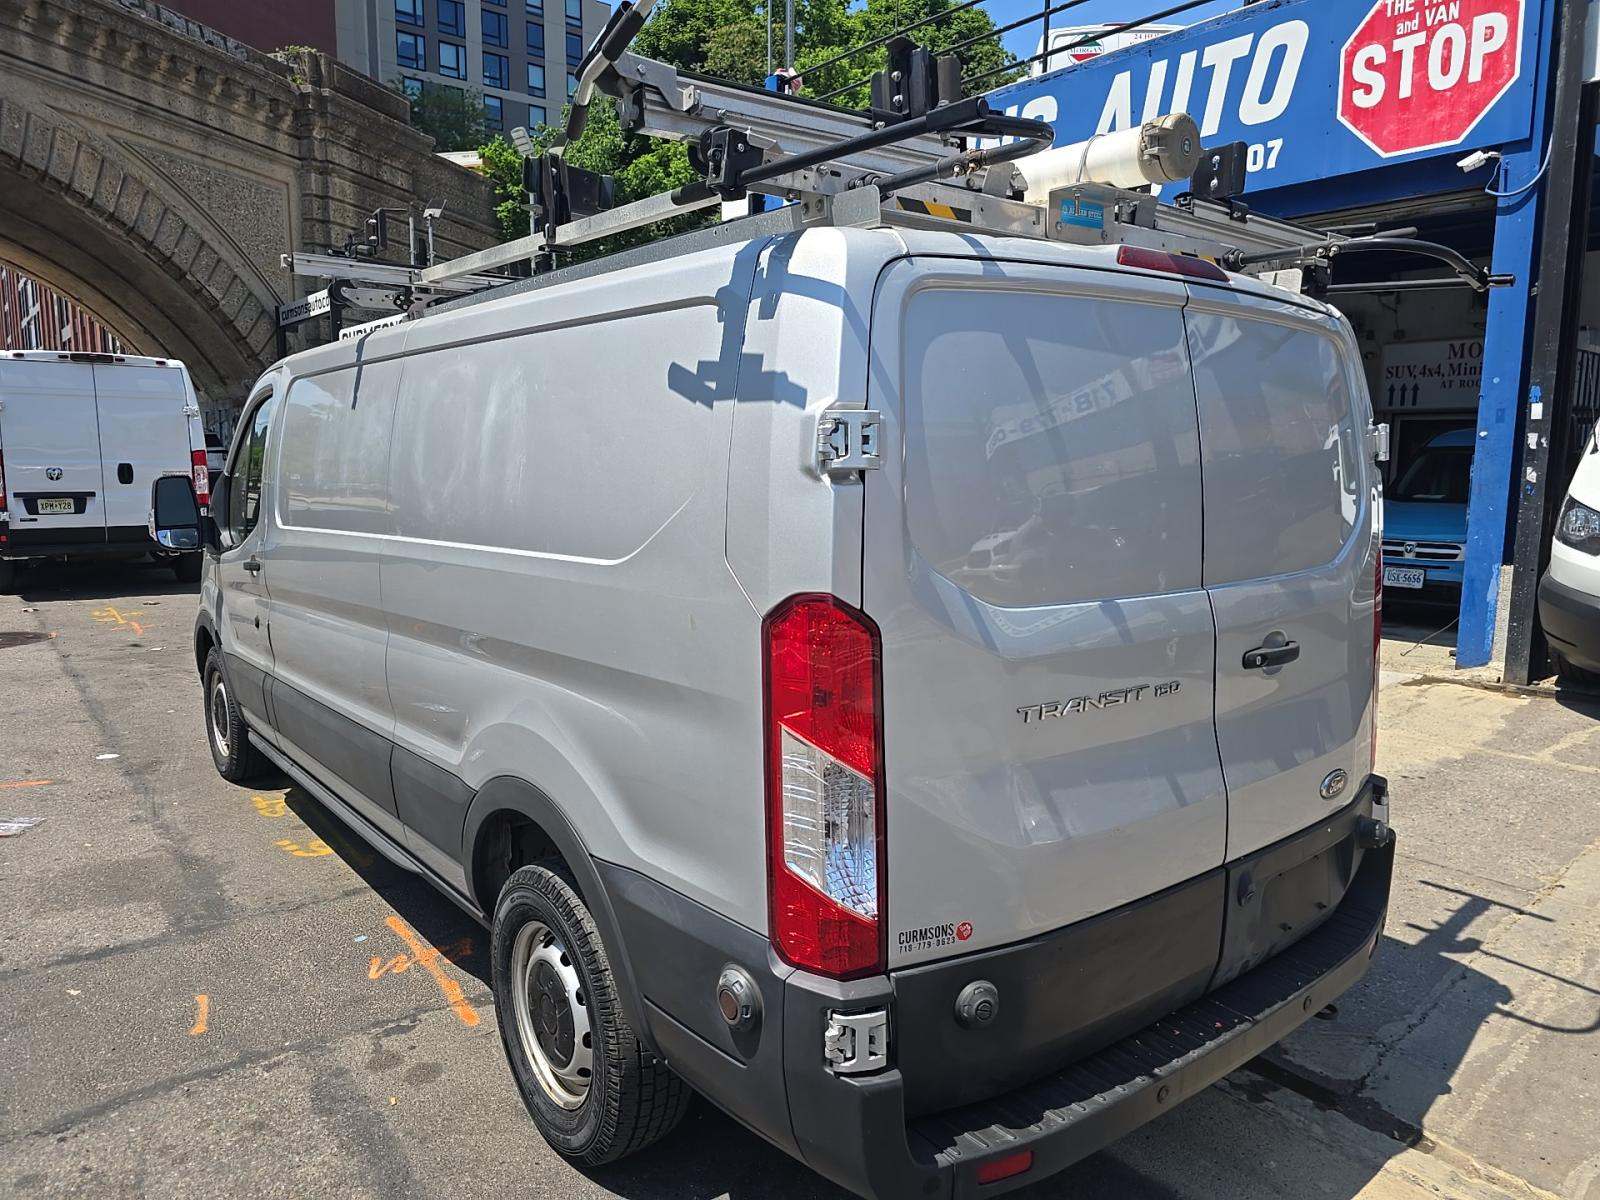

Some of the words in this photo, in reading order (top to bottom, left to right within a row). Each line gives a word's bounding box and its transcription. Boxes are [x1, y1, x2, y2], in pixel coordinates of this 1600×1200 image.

[1396, 14, 1419, 35] and
[1425, 3, 1460, 27] VAN
[1094, 19, 1309, 138] AUTO
[1352, 12, 1509, 108] STOP
[1016, 684, 1150, 723] TRANSIT
[898, 923, 954, 945] CURMSONS
